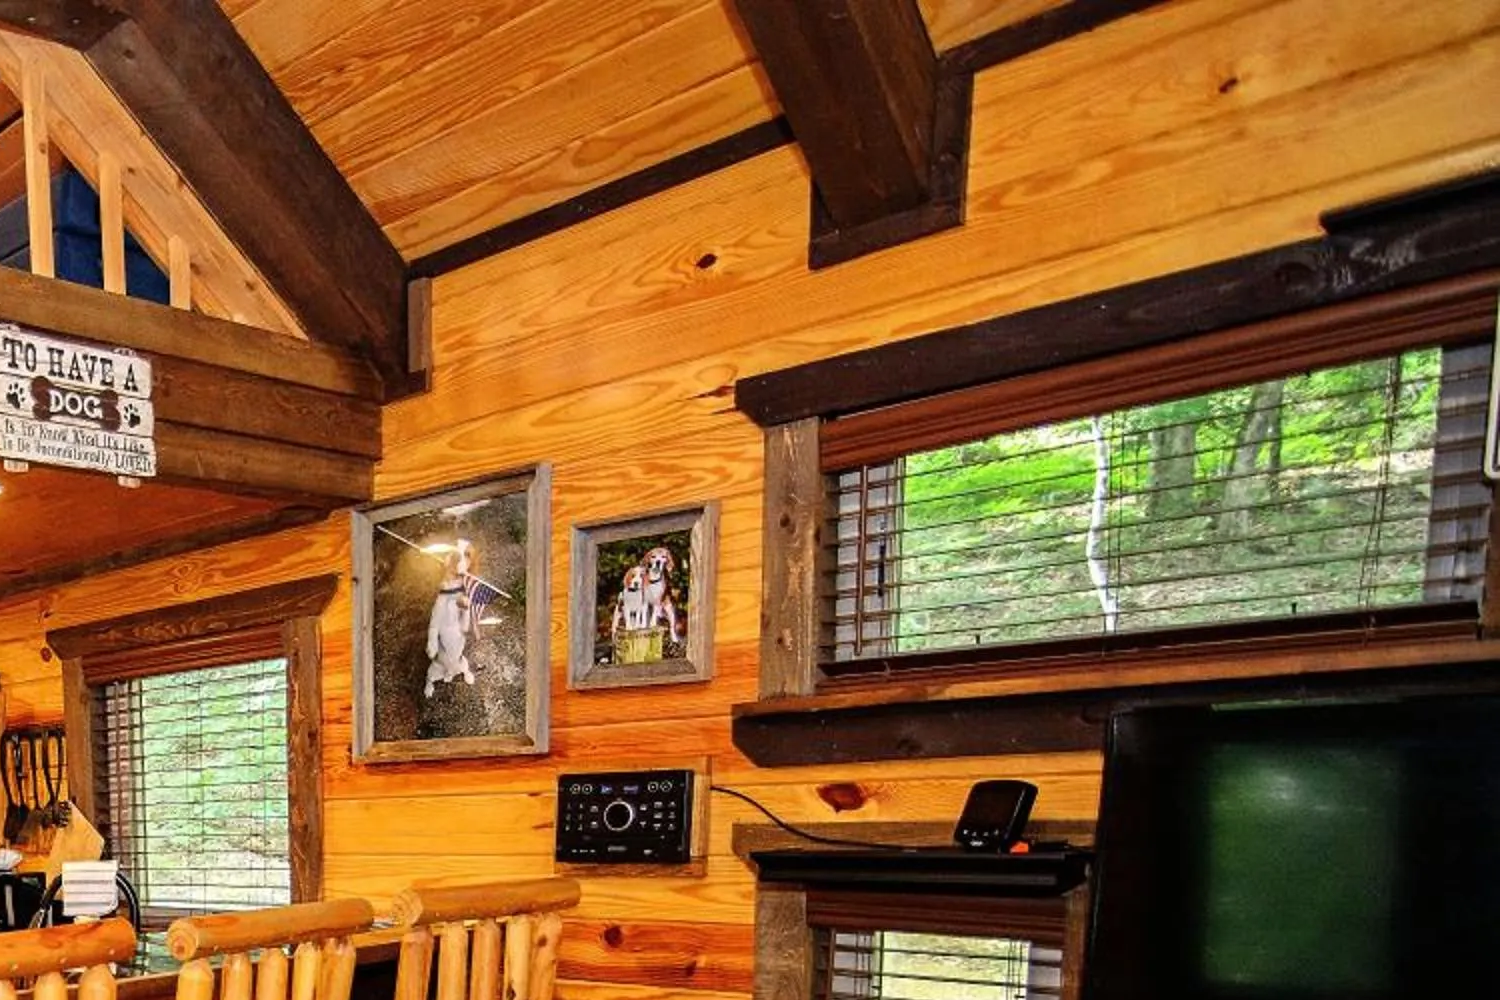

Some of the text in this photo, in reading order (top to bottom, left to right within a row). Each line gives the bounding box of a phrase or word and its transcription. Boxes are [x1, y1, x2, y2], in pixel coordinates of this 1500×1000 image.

[3, 337, 139, 392] TO HAVE A
[48, 389, 103, 419] DOG
